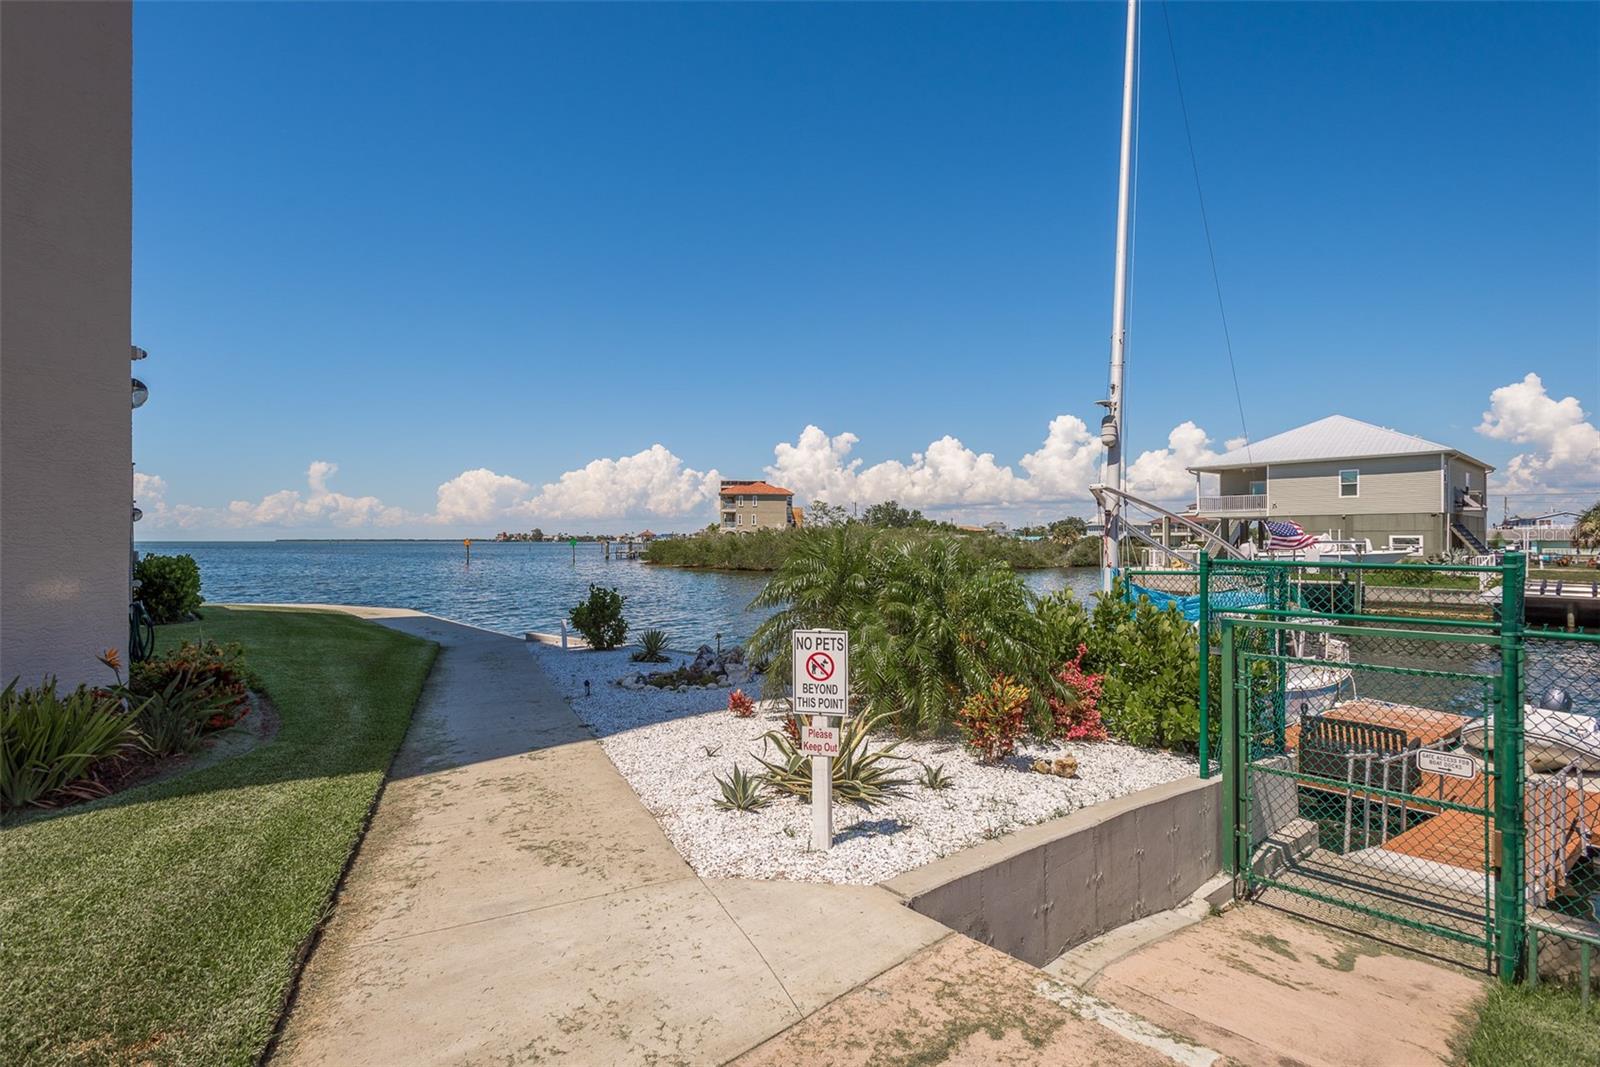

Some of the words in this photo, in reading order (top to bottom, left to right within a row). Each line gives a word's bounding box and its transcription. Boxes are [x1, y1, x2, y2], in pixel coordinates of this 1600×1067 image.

[796, 637, 812, 650] NO
[816, 637, 844, 651] PETS
[803, 683, 838, 695] BEYOND
[797, 697, 816, 708] THIS
[819, 698, 844, 709] POINT
[808, 728, 833, 739] Please
[803, 741, 822, 753] Keep
[824, 743, 838, 752] Out
[1436, 755, 1458, 763] ACCESS
